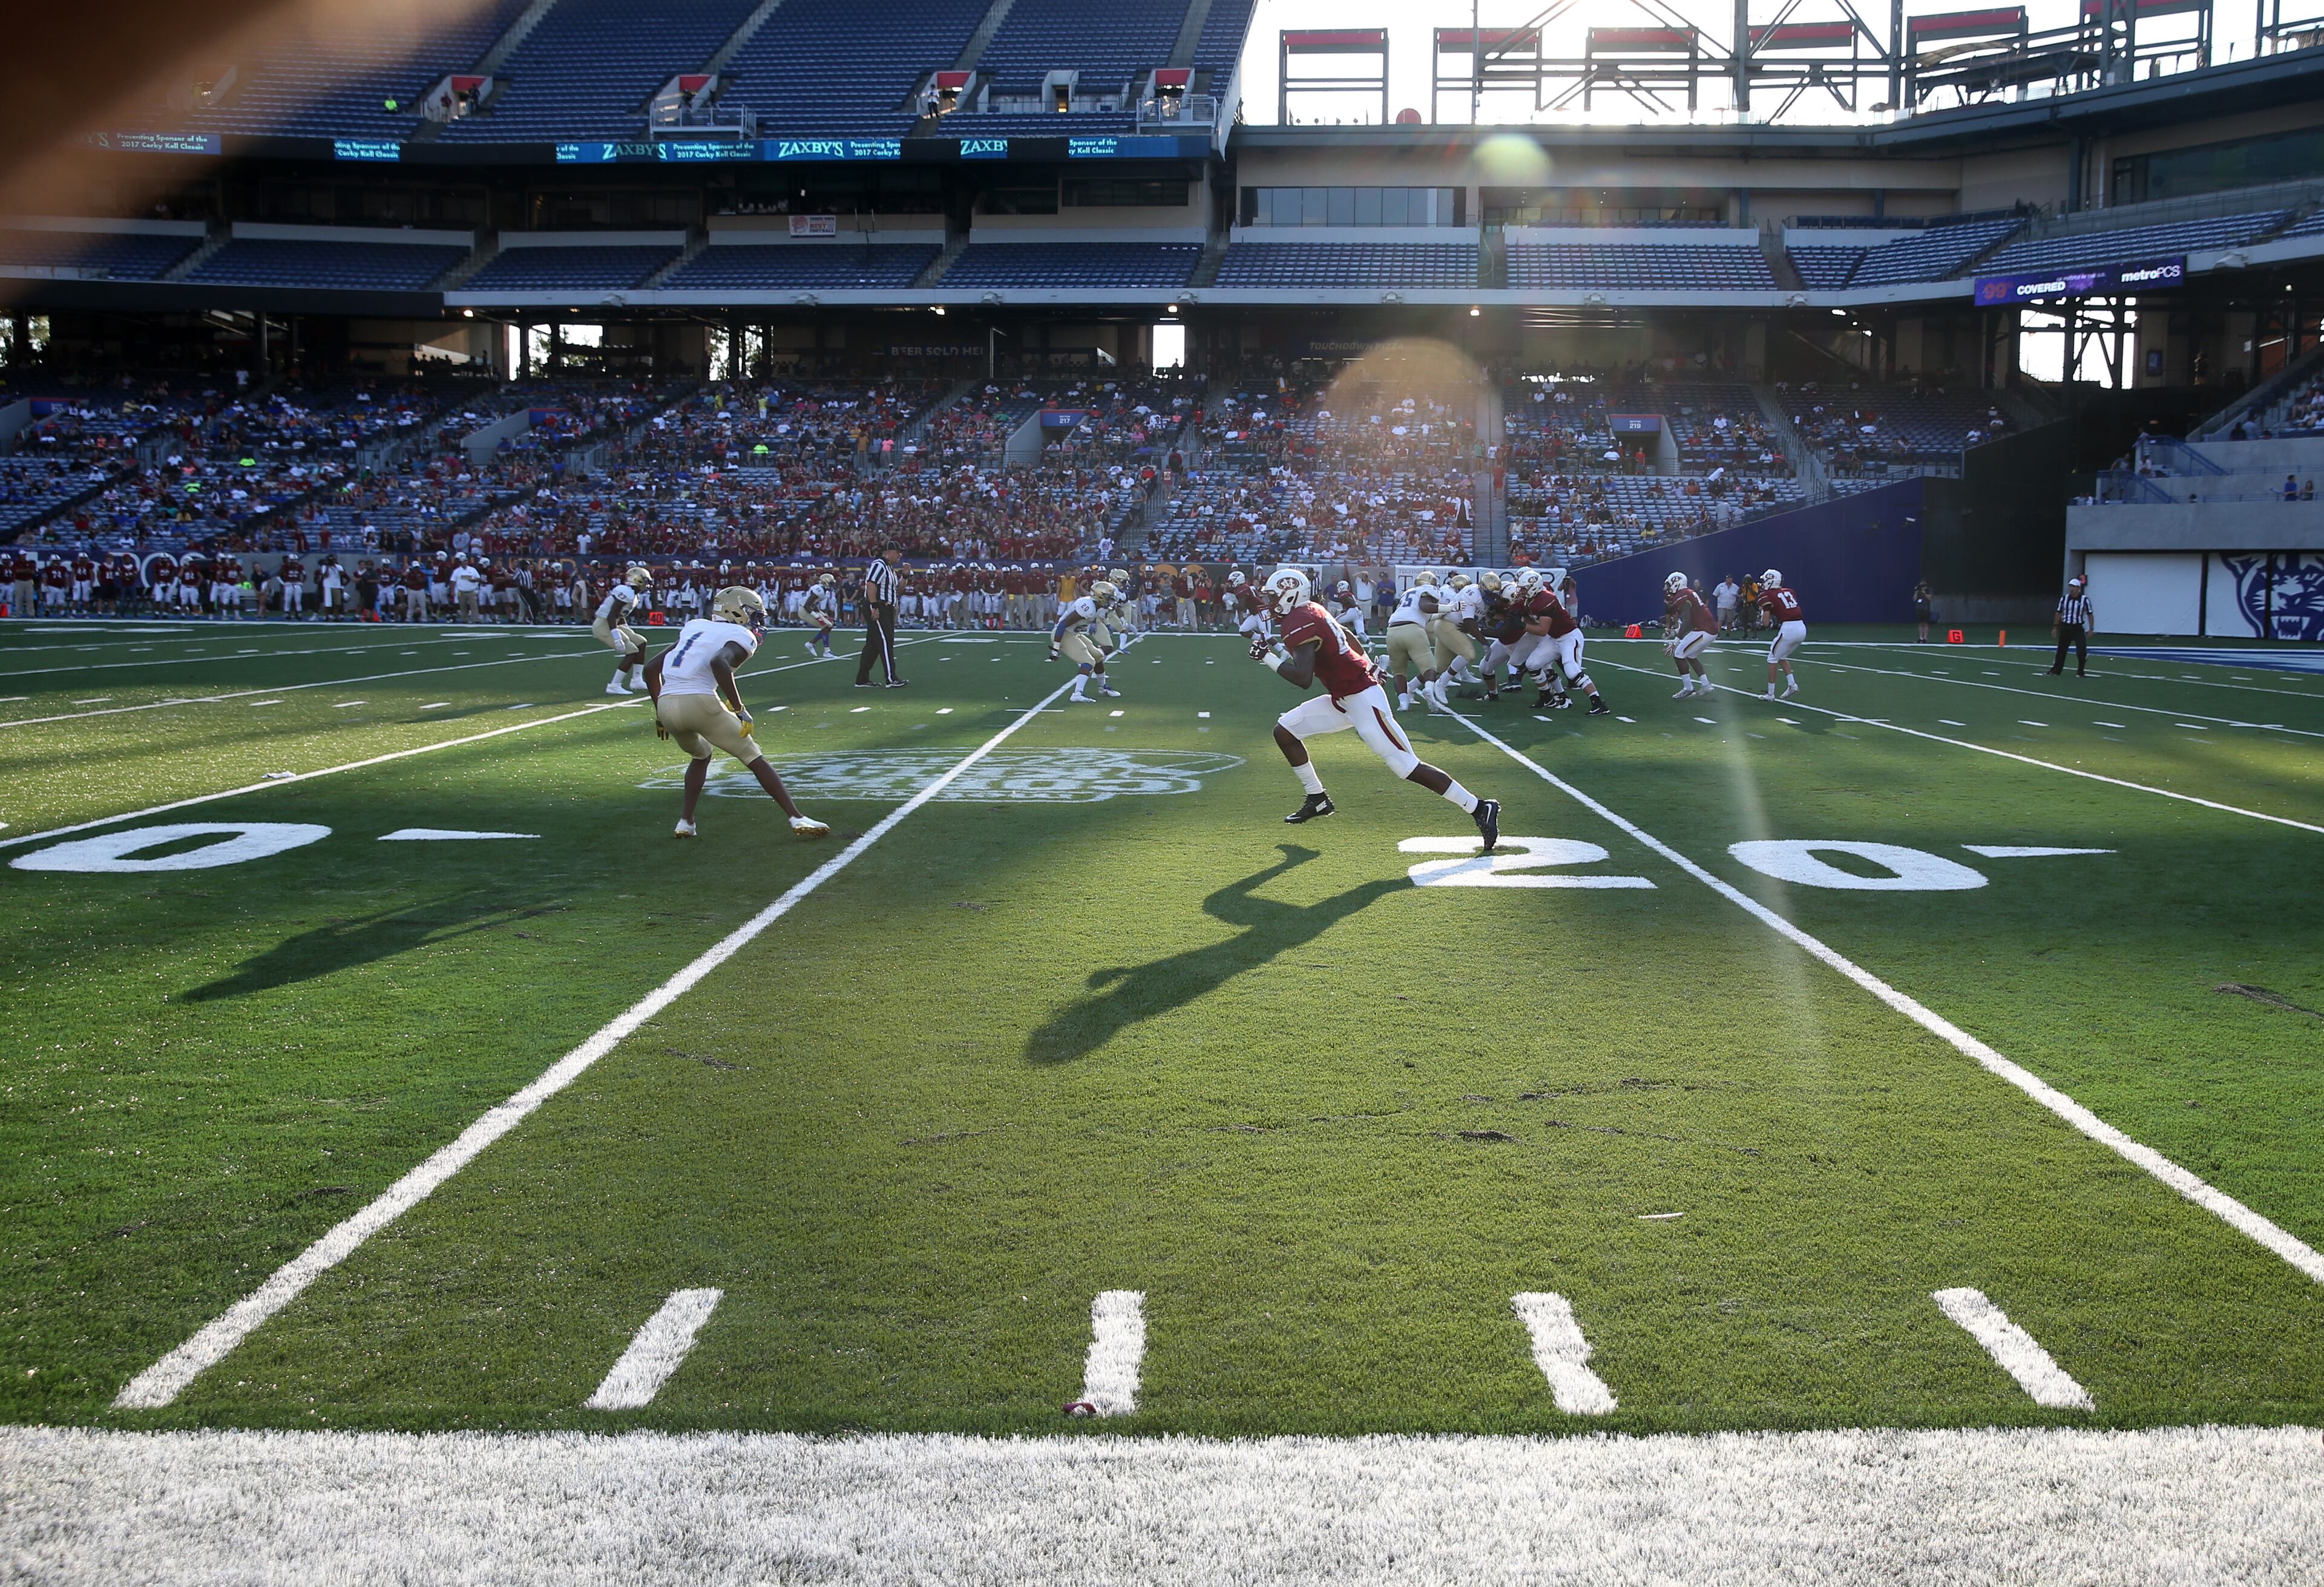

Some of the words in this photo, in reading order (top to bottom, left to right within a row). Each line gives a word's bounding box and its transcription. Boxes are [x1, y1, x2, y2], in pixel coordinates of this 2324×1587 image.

[117, 133, 155, 141] Presenting
[352, 142, 381, 151] Sponsor
[602, 143, 667, 160] ZAXBY'S
[778, 142, 844, 158] ZAXBY'S
[338, 149, 359, 158] Corky
[375, 150, 398, 159] Classic
[2121, 265, 2181, 283] metroPCS
[2017, 281, 2066, 295] COVERED
[891, 347, 922, 356] BEER
[926, 347, 959, 356] SOLD
[1777, 591, 1798, 609] 13
[1081, 603, 1090, 612] 20
[651, 612, 663, 623] 40
[1952, 631, 1961, 641] G
[672, 631, 704, 668] 1
[8, 822, 333, 872] 0
